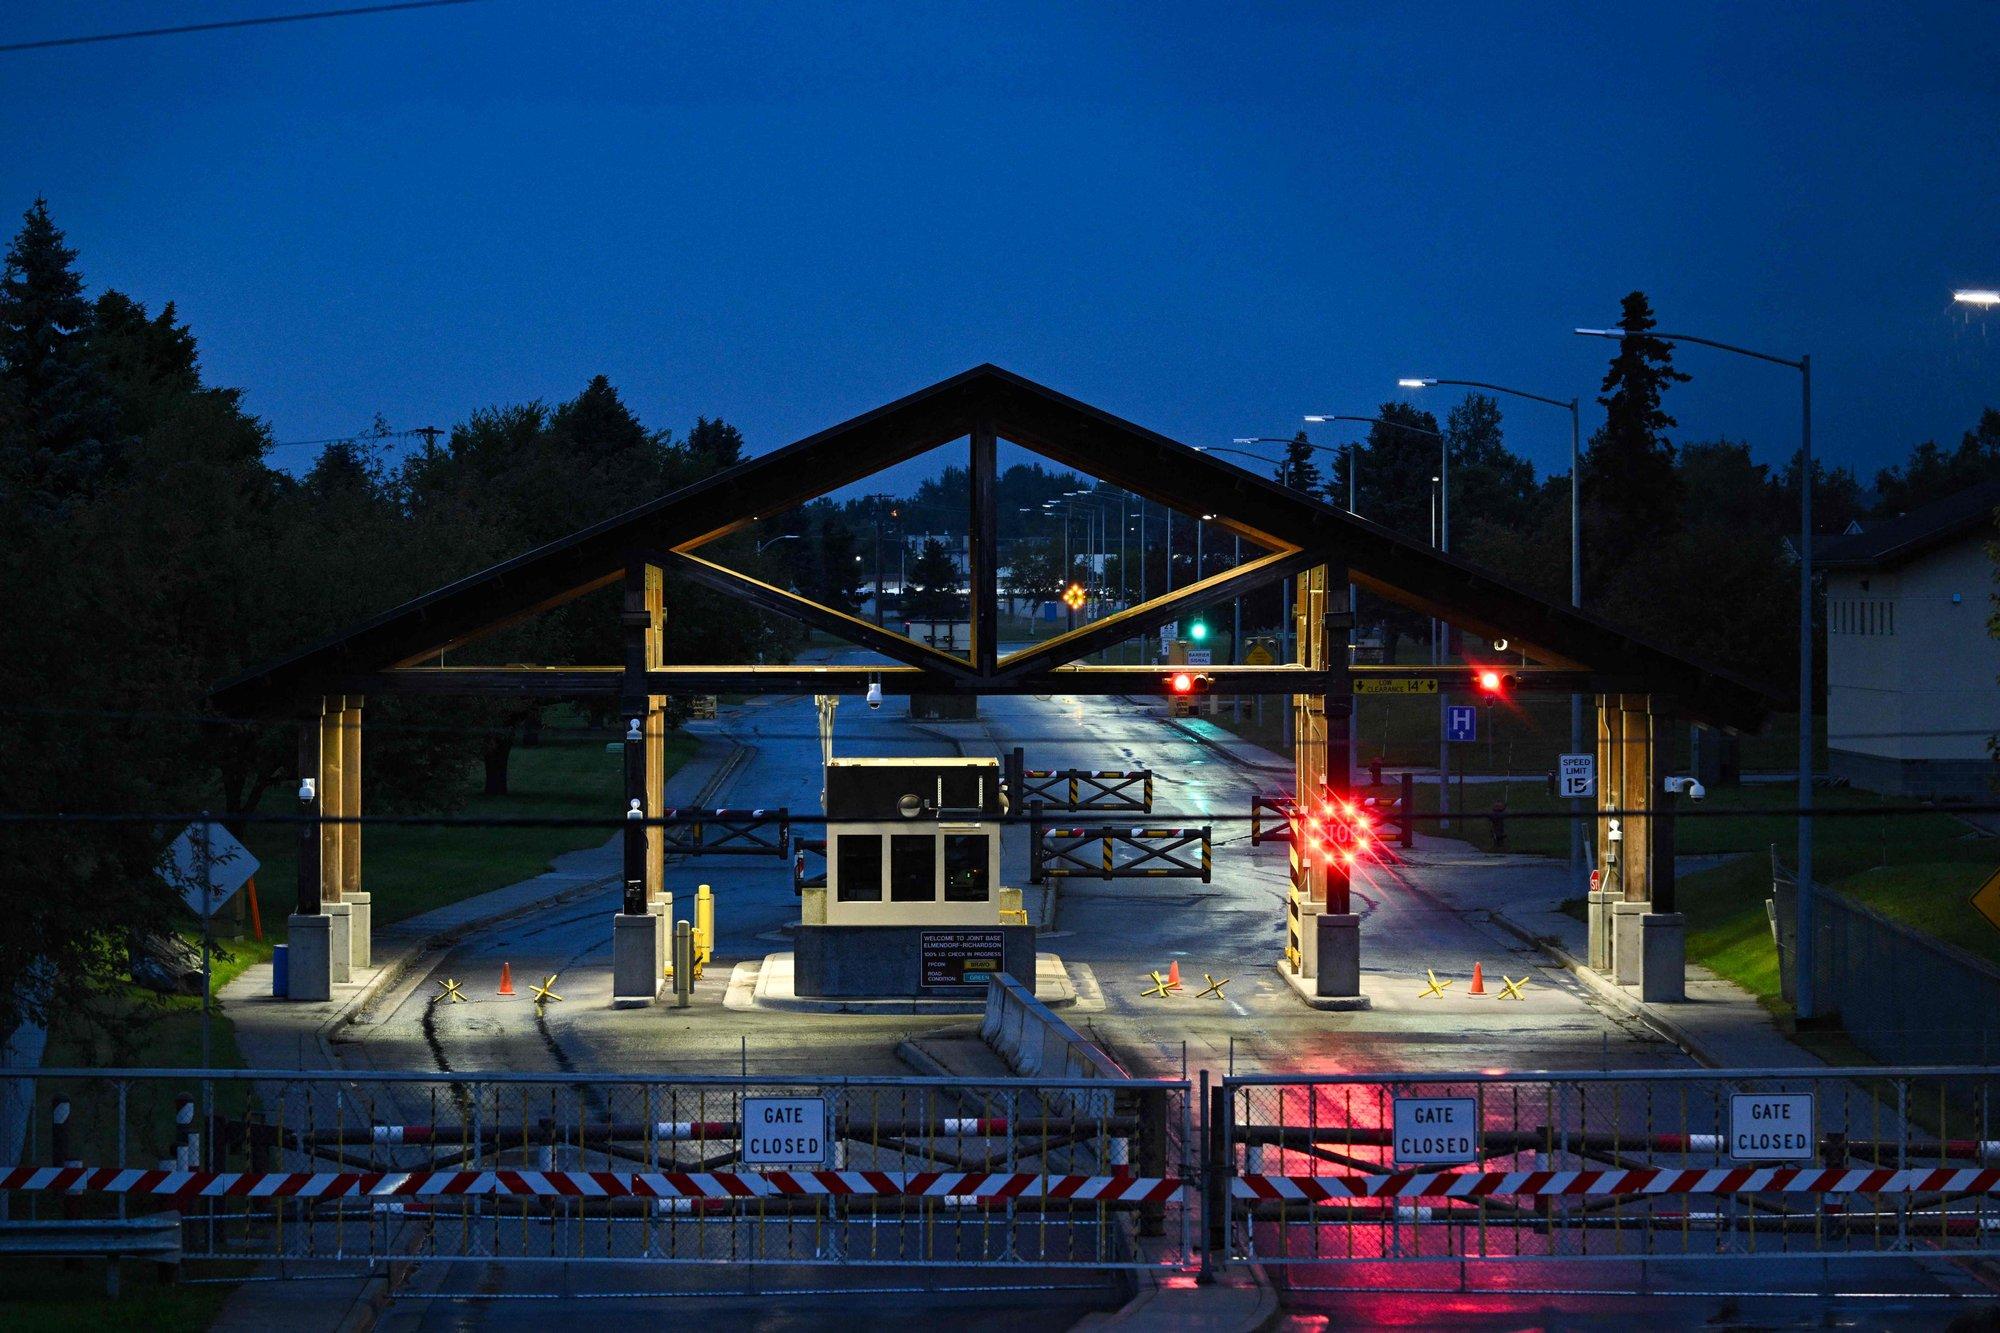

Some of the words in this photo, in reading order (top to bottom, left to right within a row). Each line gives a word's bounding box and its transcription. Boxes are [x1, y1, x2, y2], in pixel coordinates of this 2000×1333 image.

[1453, 709, 1470, 730] H
[1566, 778, 1587, 793] 15
[764, 1107, 803, 1123] GATE
[1415, 1107, 1454, 1123] GATE
[1752, 1103, 1791, 1120] GATE
[750, 1138, 818, 1154] CLOSED
[1401, 1137, 1469, 1153] CLOSED
[1738, 1133, 1806, 1150] CLOSED
